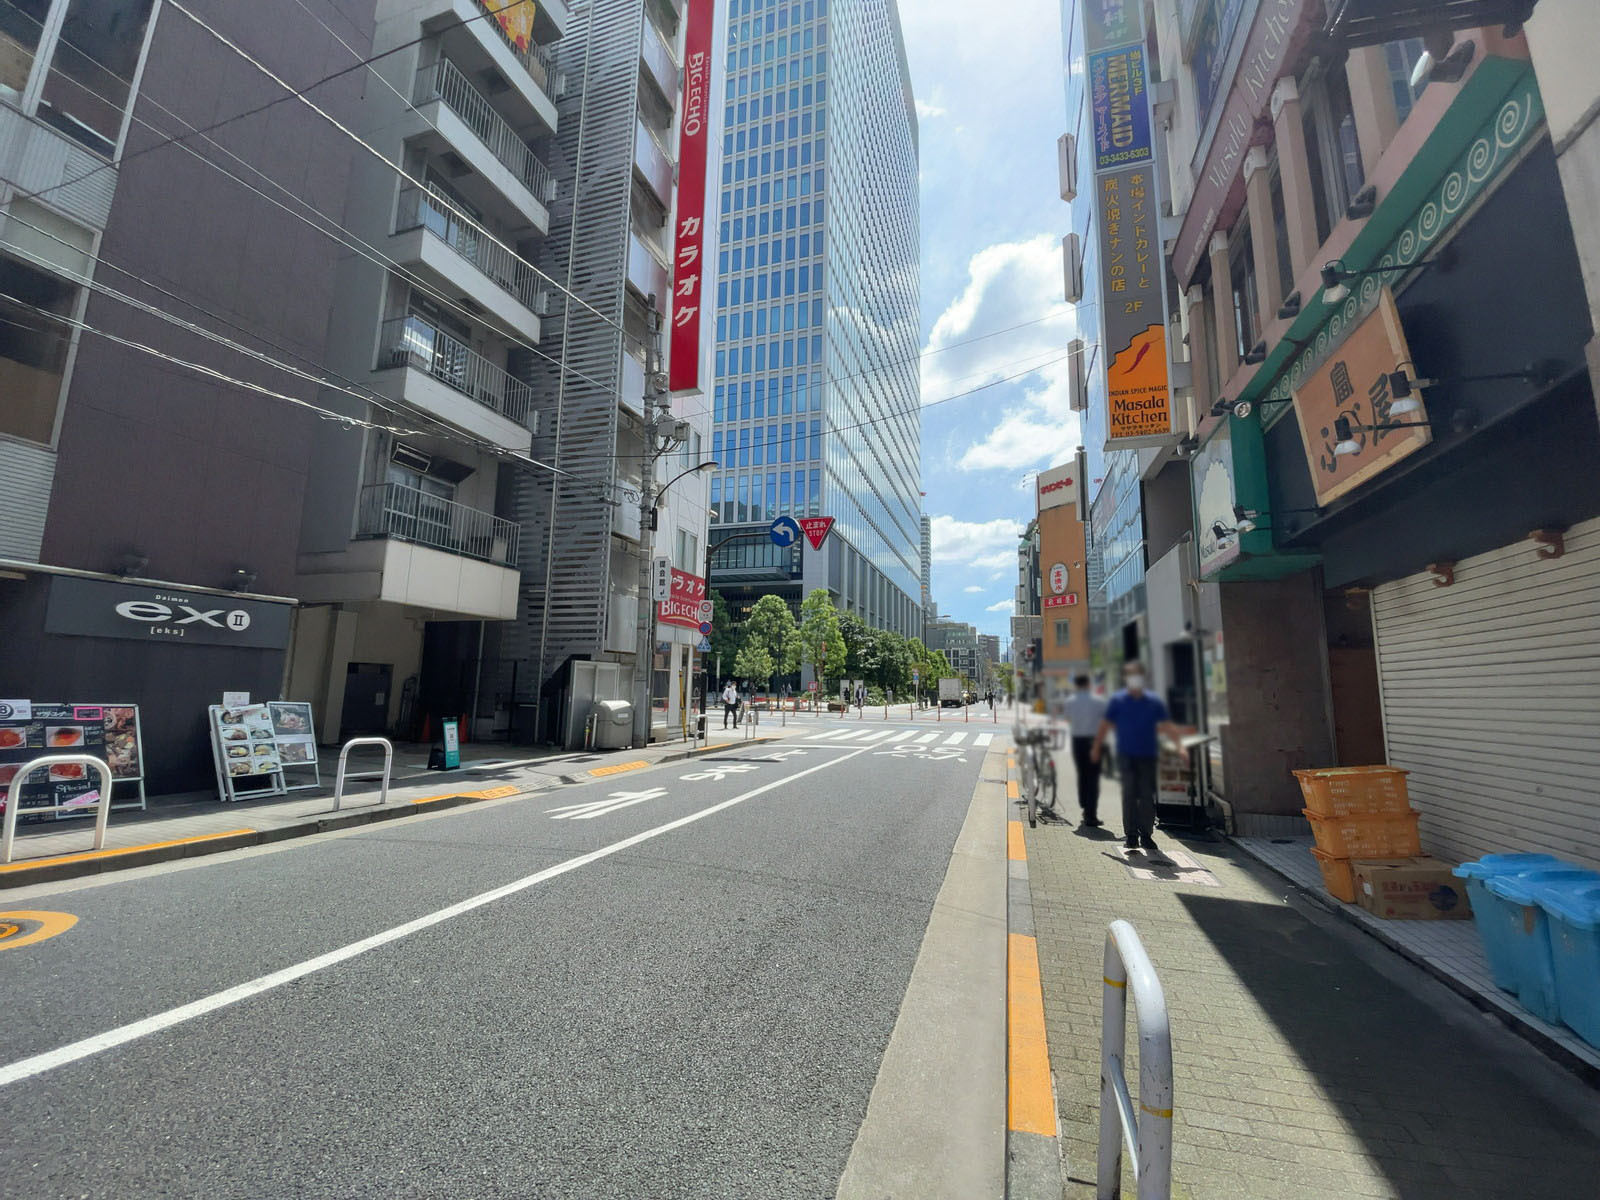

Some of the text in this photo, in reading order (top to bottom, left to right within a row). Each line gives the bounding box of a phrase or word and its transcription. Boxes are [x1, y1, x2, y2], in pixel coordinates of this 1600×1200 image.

[1107, 54, 1134, 147] MERMAID
[1105, 178, 1126, 292] 炭火焼きナンの店
[675, 216, 700, 327] カラオケ
[1125, 301, 1143, 313] 2F
[1108, 389, 1129, 397] INDIAN
[1114, 395, 1165, 412] Masala
[1111, 410, 1168, 426] Kitchen
[805, 521, 827, 530] 止まれ
[155, 594, 190, 603] Daimon
[115, 600, 226, 628] ex
[56, 782, 91, 793] Special
